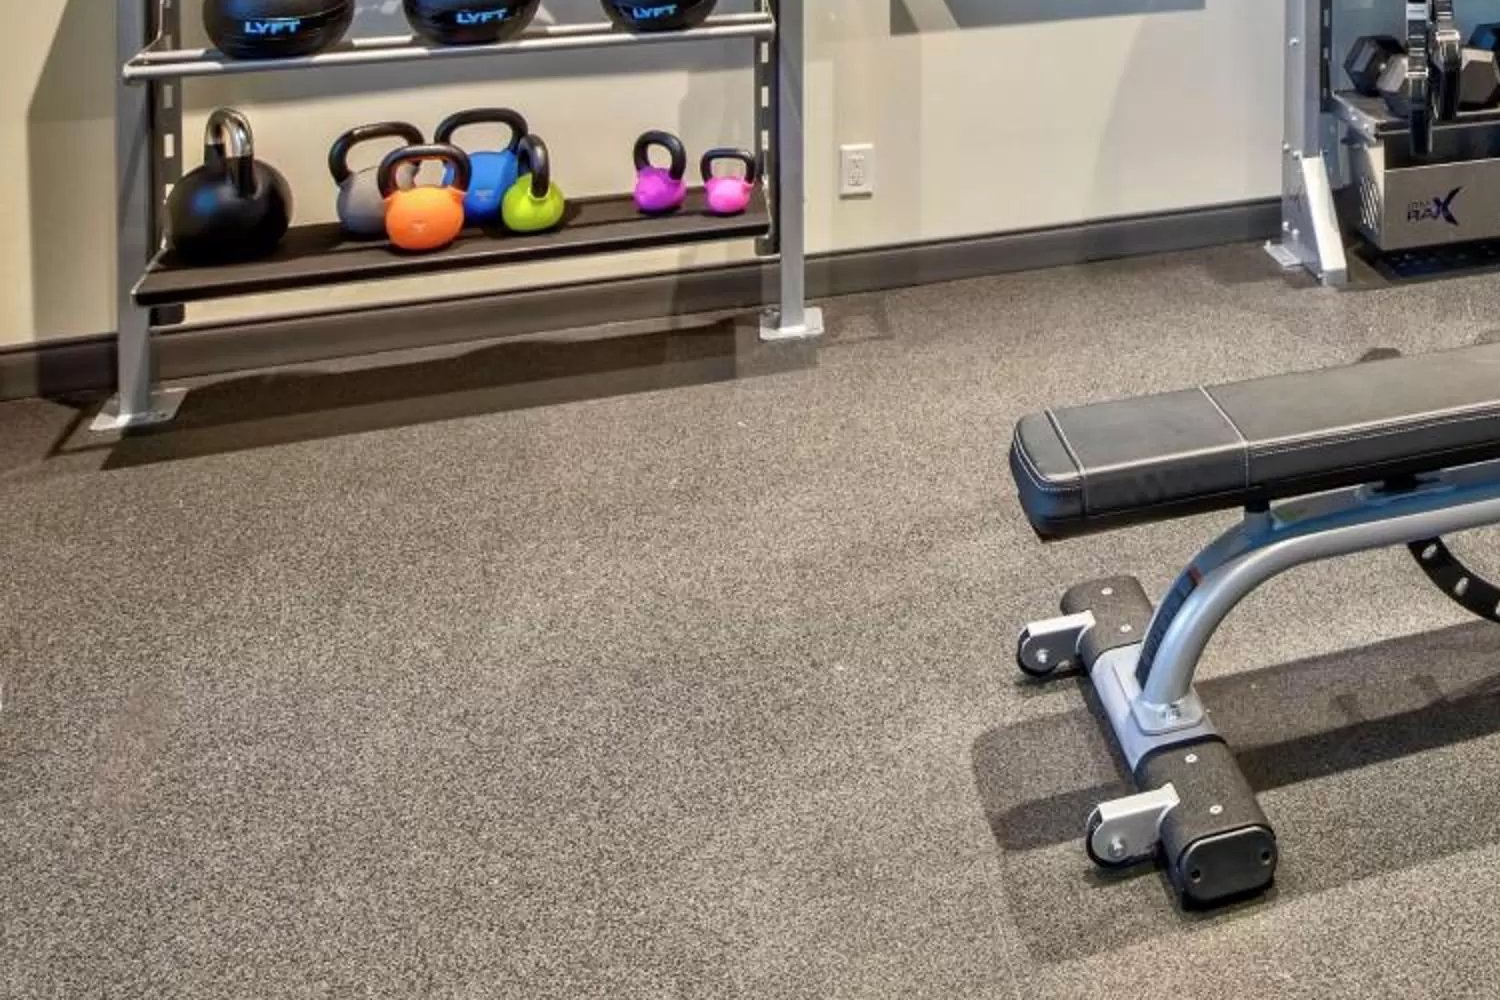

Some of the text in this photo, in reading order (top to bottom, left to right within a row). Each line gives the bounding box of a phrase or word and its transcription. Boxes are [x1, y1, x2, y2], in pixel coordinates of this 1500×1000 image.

[456, 7, 508, 24] LYFT
[632, 3, 679, 19] LYFT
[244, 19, 301, 34] LYFT
